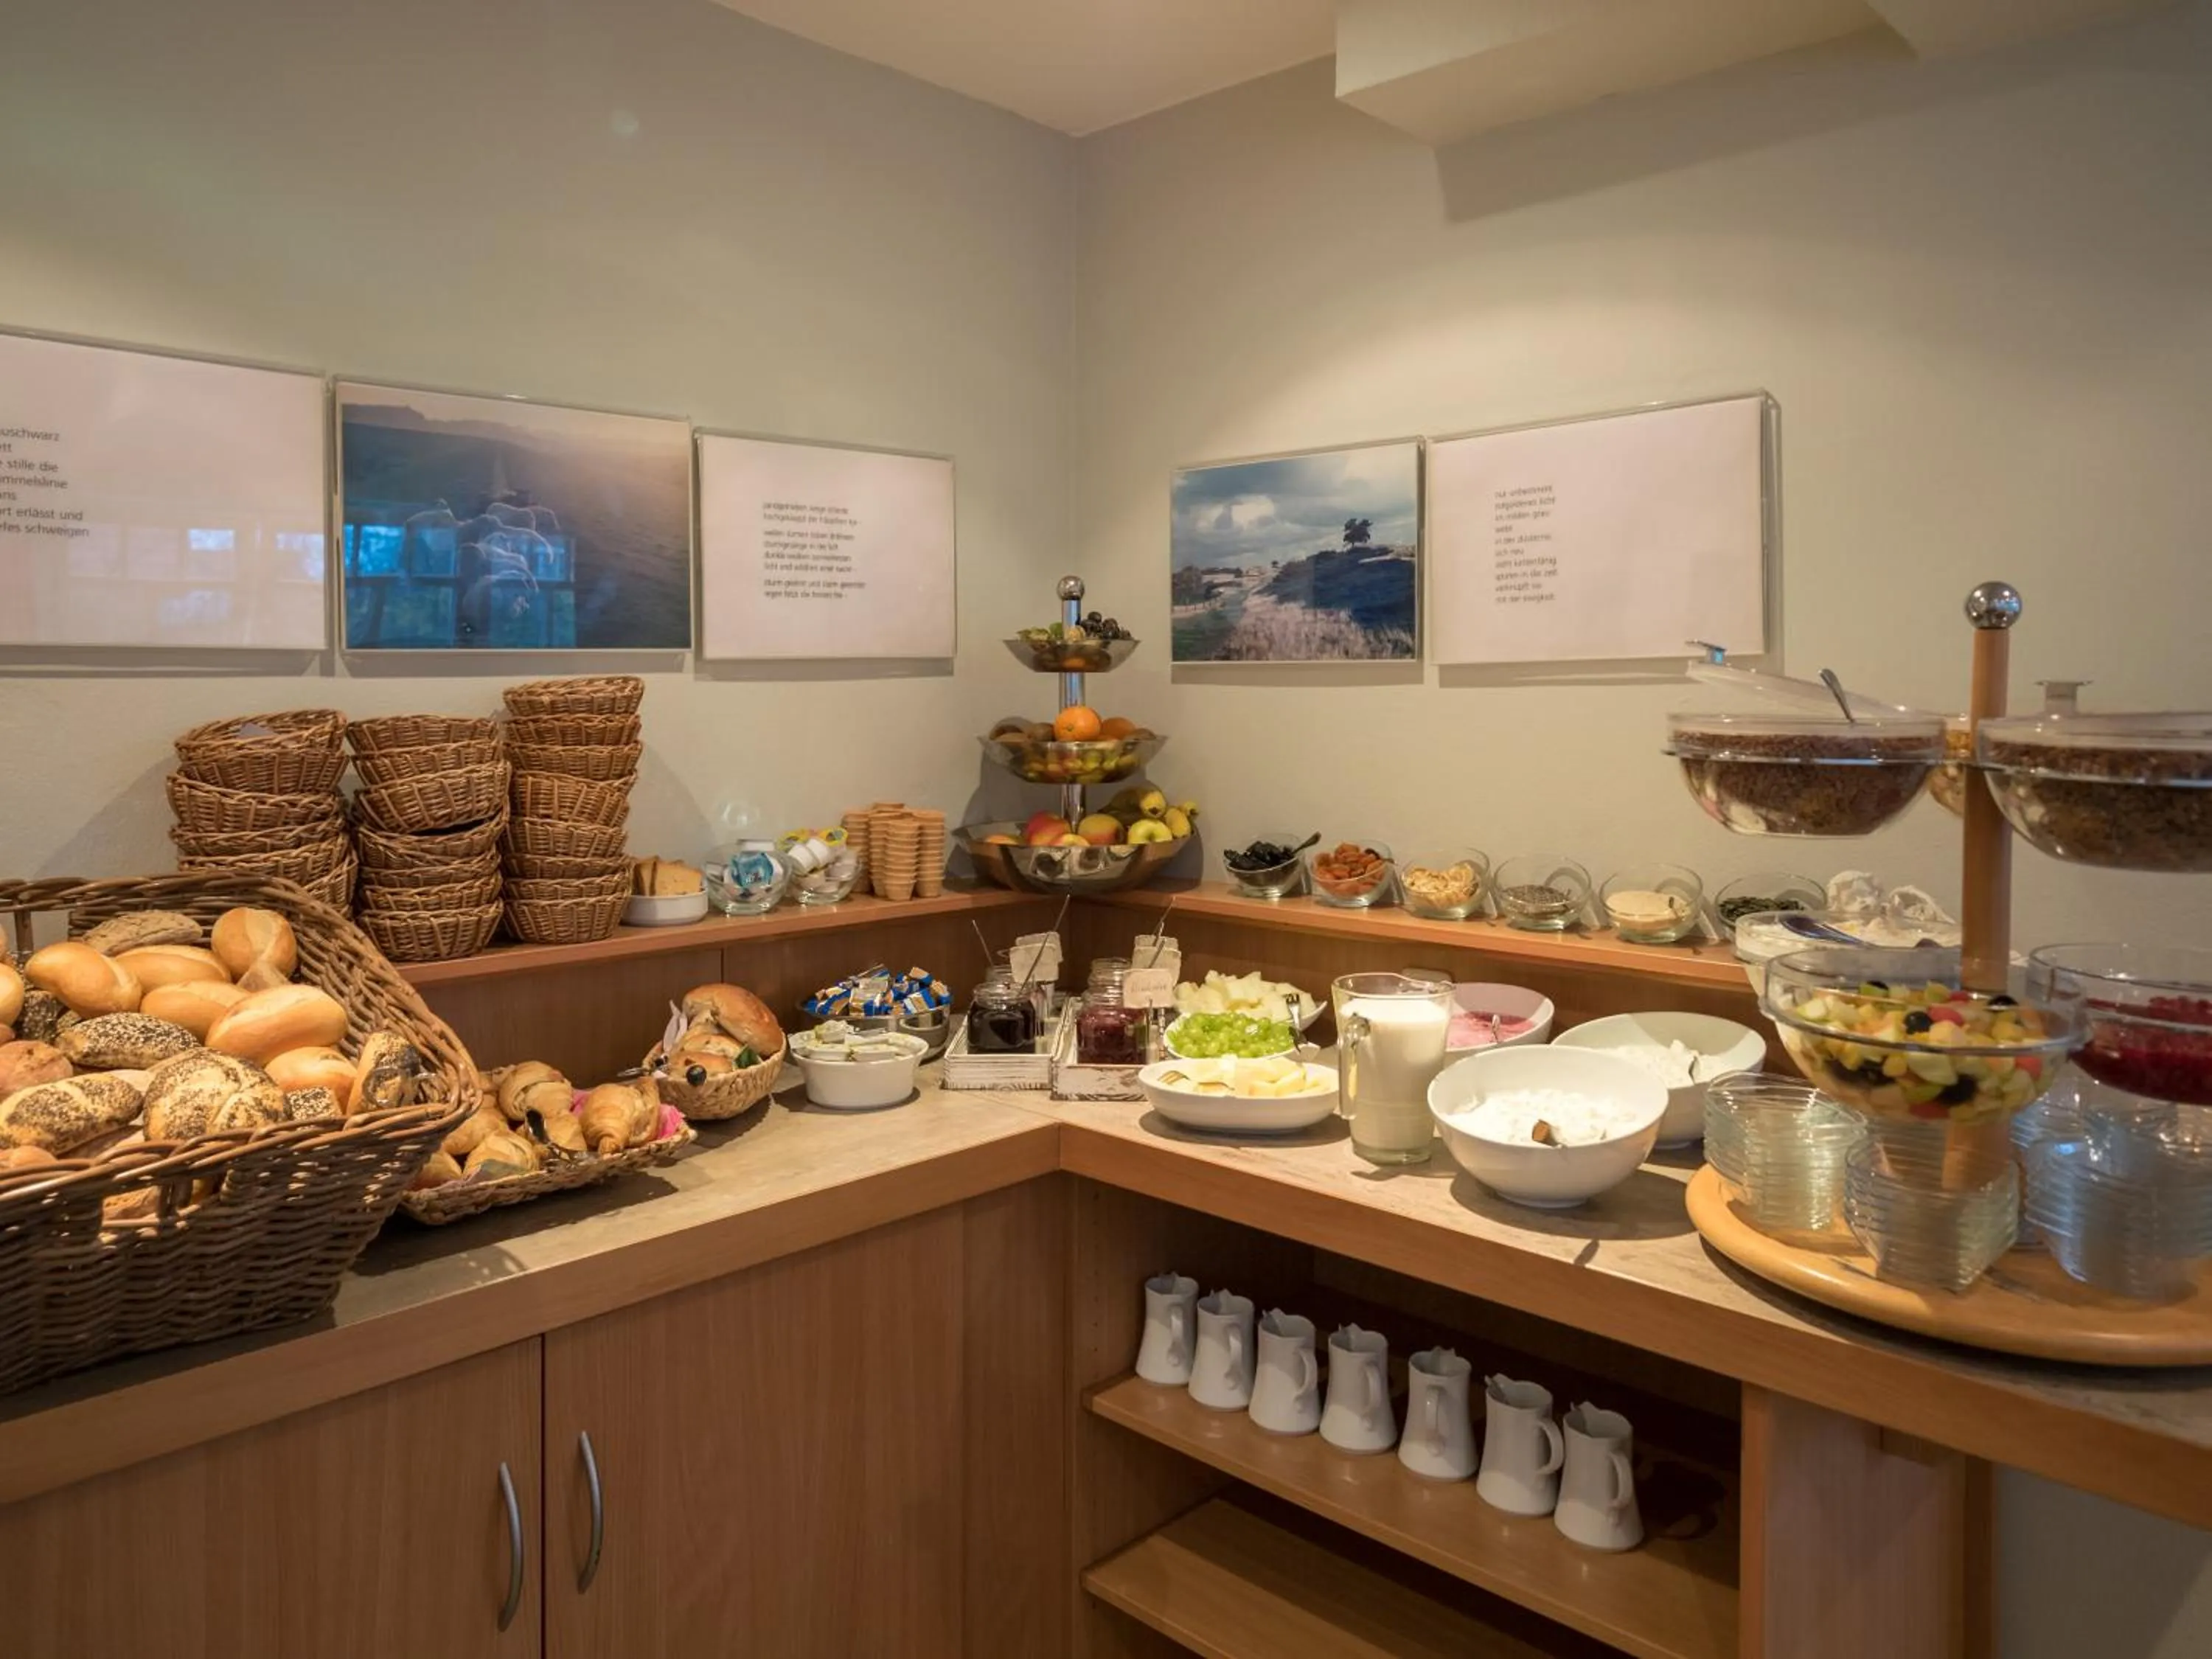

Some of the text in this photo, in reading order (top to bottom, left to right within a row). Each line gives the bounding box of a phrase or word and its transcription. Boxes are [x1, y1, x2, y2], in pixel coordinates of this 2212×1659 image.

[0, 428, 60, 442] uschwarz
[0, 443, 12, 453] tt
[7, 459, 35, 471] stille
[39, 462, 59, 473] die
[0, 492, 17, 501] ns
[0, 507, 11, 516] rt
[60, 510, 83, 521] und
[25, 523, 89, 538] schweigen
